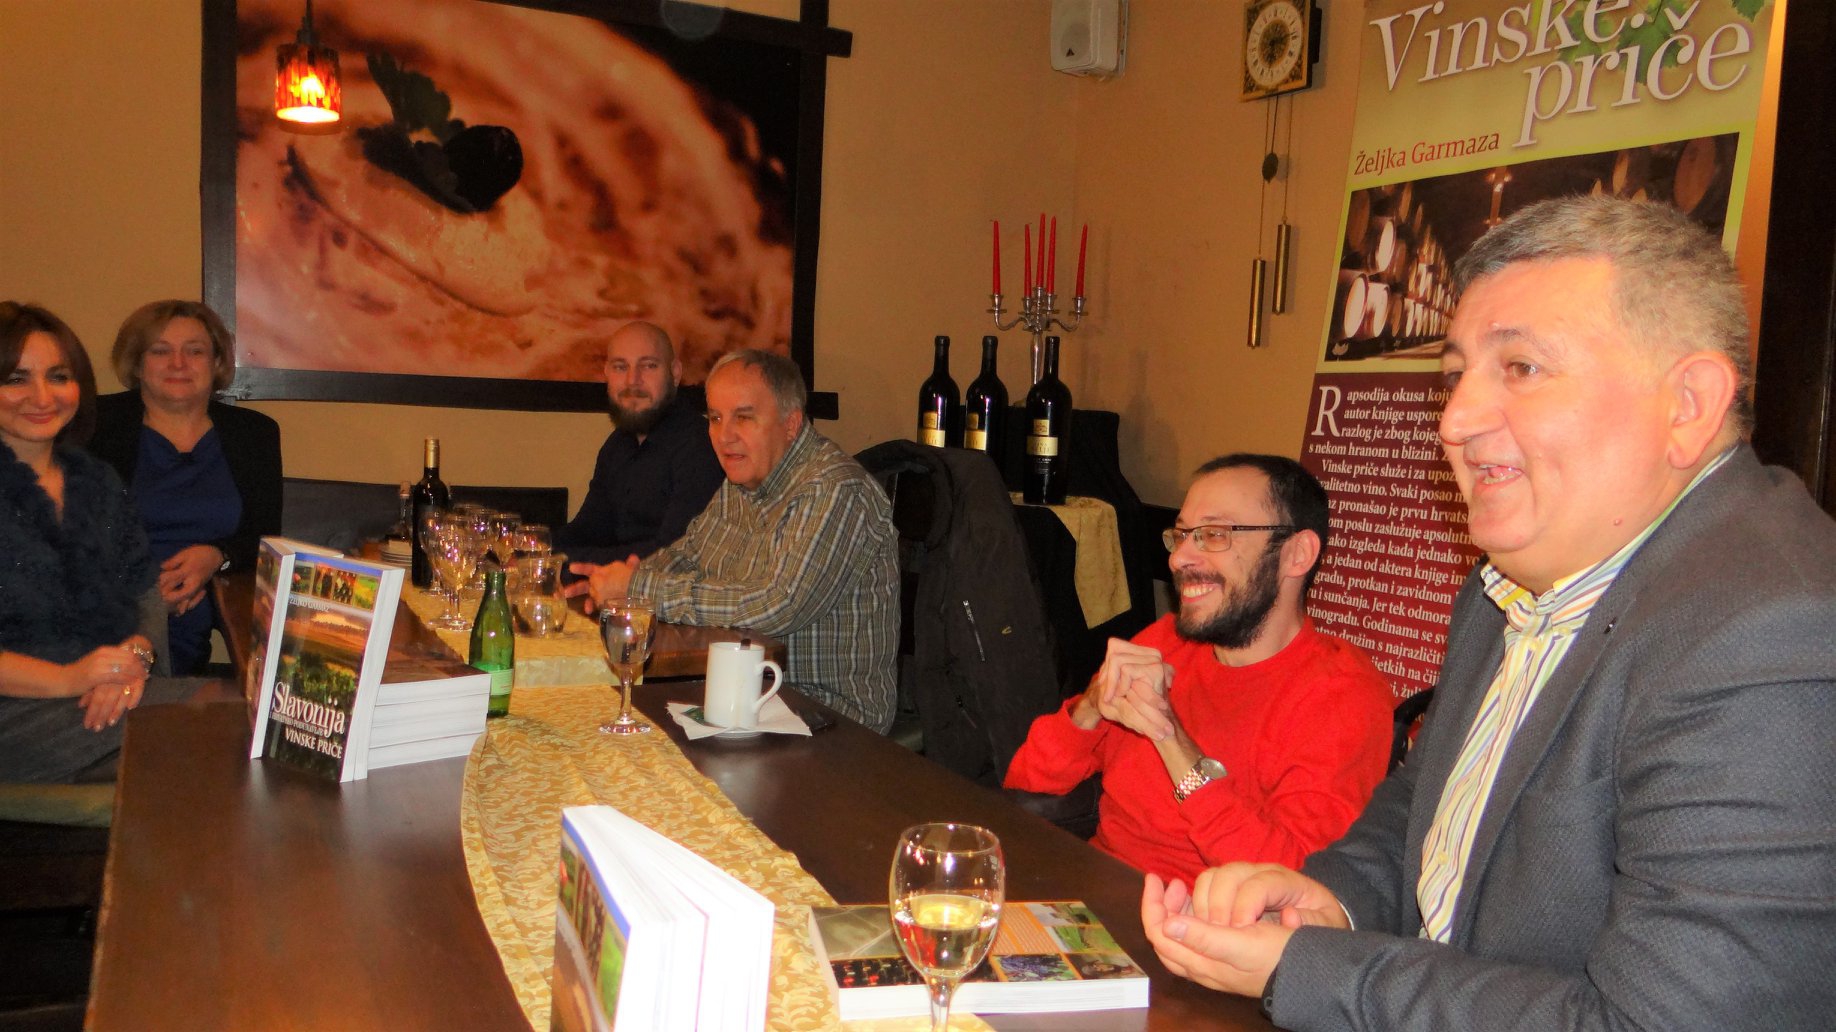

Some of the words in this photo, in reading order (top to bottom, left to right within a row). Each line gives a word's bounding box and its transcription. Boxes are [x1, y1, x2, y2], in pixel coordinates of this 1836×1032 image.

[1369, 0, 1629, 92] Vinske
[1511, 1, 1752, 149] priče
[1353, 150, 1406, 177] Željka
[1411, 132, 1500, 165] Garmaza
[1346, 387, 1389, 405] apsodija
[1392, 388, 1424, 402] okusa
[1344, 406, 1370, 420] autor
[1372, 406, 1404, 424] knjige
[1341, 424, 1374, 442] razlog
[1372, 426, 1382, 442] je
[1384, 426, 1410, 444] zbog
[1308, 444, 1314, 453] s
[1315, 440, 1348, 454] nekom
[1348, 442, 1389, 458] hranom
[1392, 449, 1399, 458] u
[1401, 444, 1439, 462] blizini.
[1322, 459, 1352, 474] Vinske
[1354, 460, 1378, 478] priče
[1380, 462, 1406, 478] služe
[1408, 464, 1412, 479] i
[1413, 469, 1425, 480] za
[1428, 470, 1456, 483] upoz
[1316, 476, 1361, 493] valitetno
[1362, 480, 1388, 496] vino.
[1390, 483, 1418, 500] Svaki
[1420, 488, 1454, 504] posao
[1338, 499, 1387, 514] pronašao
[1387, 506, 1399, 520] je
[1400, 508, 1428, 521] prvu
[1430, 506, 1470, 524] hrvats
[1344, 518, 1372, 534] poslu
[1374, 521, 1422, 540] zaslužuje
[1349, 536, 1386, 554] izgleda
[1388, 540, 1414, 558] kada
[1416, 542, 1462, 566] jednako
[1326, 554, 1332, 564] a
[1334, 553, 1362, 570] jedan
[1364, 559, 1376, 572] od
[1378, 560, 1412, 578] aktera
[1414, 564, 1449, 586] knjige
[1318, 586, 1322, 600] i
[1324, 591, 1370, 614] sunčanja.
[1371, 598, 1388, 613] Jer
[1388, 601, 1406, 616] tek
[1348, 576, 1389, 594] protkan
[1390, 581, 1394, 594] i
[1396, 585, 1451, 605] zavidnom
[1306, 604, 1360, 627] vinogradu.
[1362, 615, 1418, 640] Godinama
[1421, 632, 1433, 642] se
[1434, 634, 1449, 646] sv
[1378, 640, 1382, 651] s
[1408, 669, 1420, 681] na
[273, 682, 346, 738] Slavonija
[286, 724, 316, 750] VINSKE
